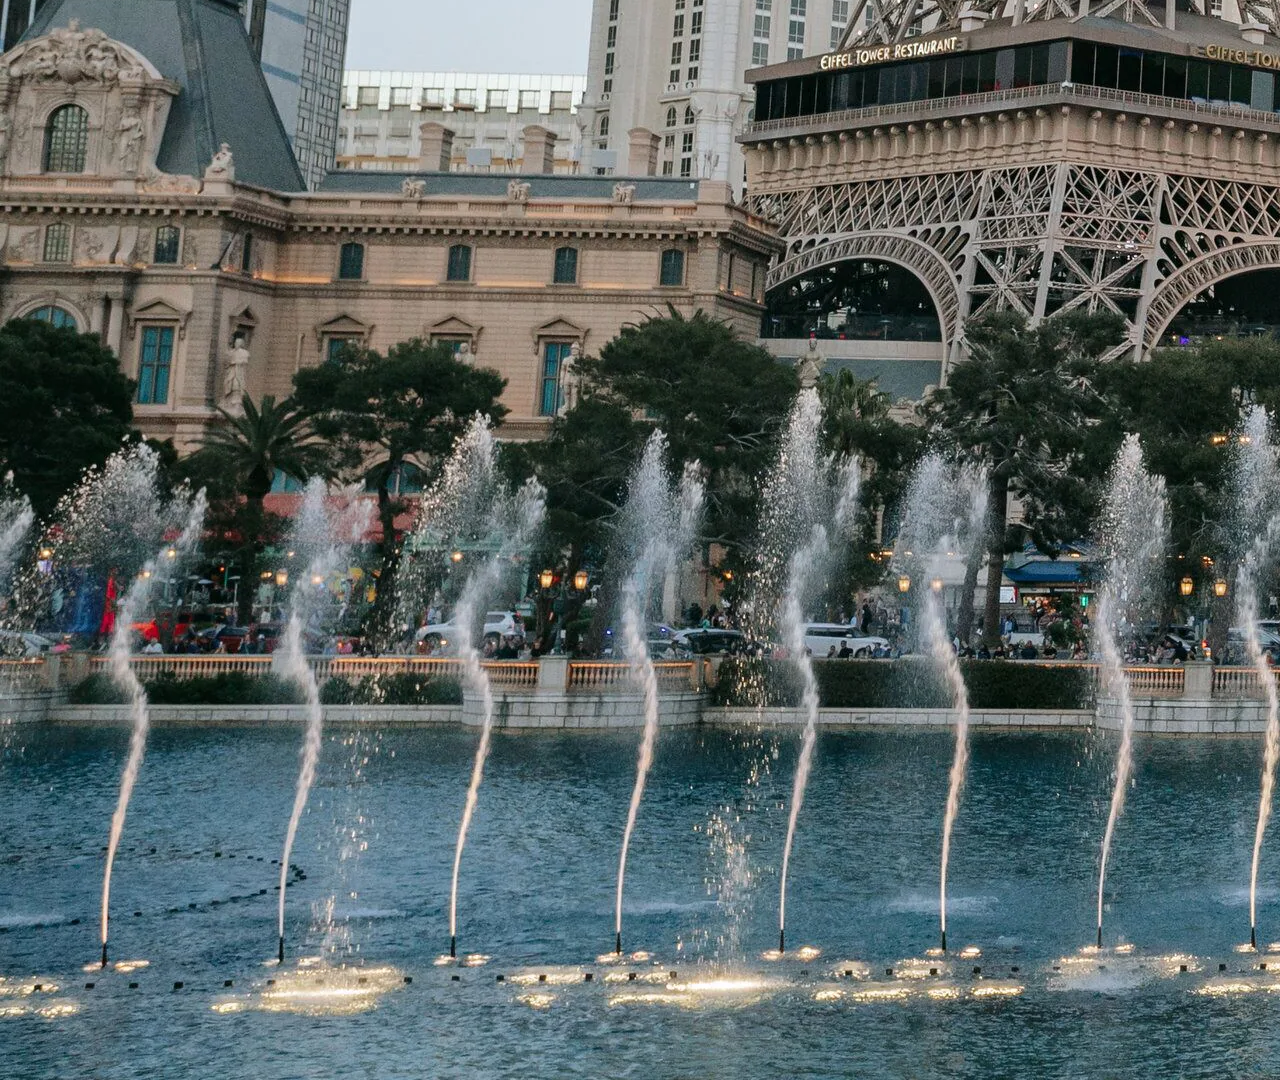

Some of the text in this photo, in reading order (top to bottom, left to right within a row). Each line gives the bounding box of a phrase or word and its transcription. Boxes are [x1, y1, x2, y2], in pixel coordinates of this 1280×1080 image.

[820, 36, 958, 70] EIFFEL TOWER RESTAURANT
[1206, 43, 1250, 63] EIFFEL
